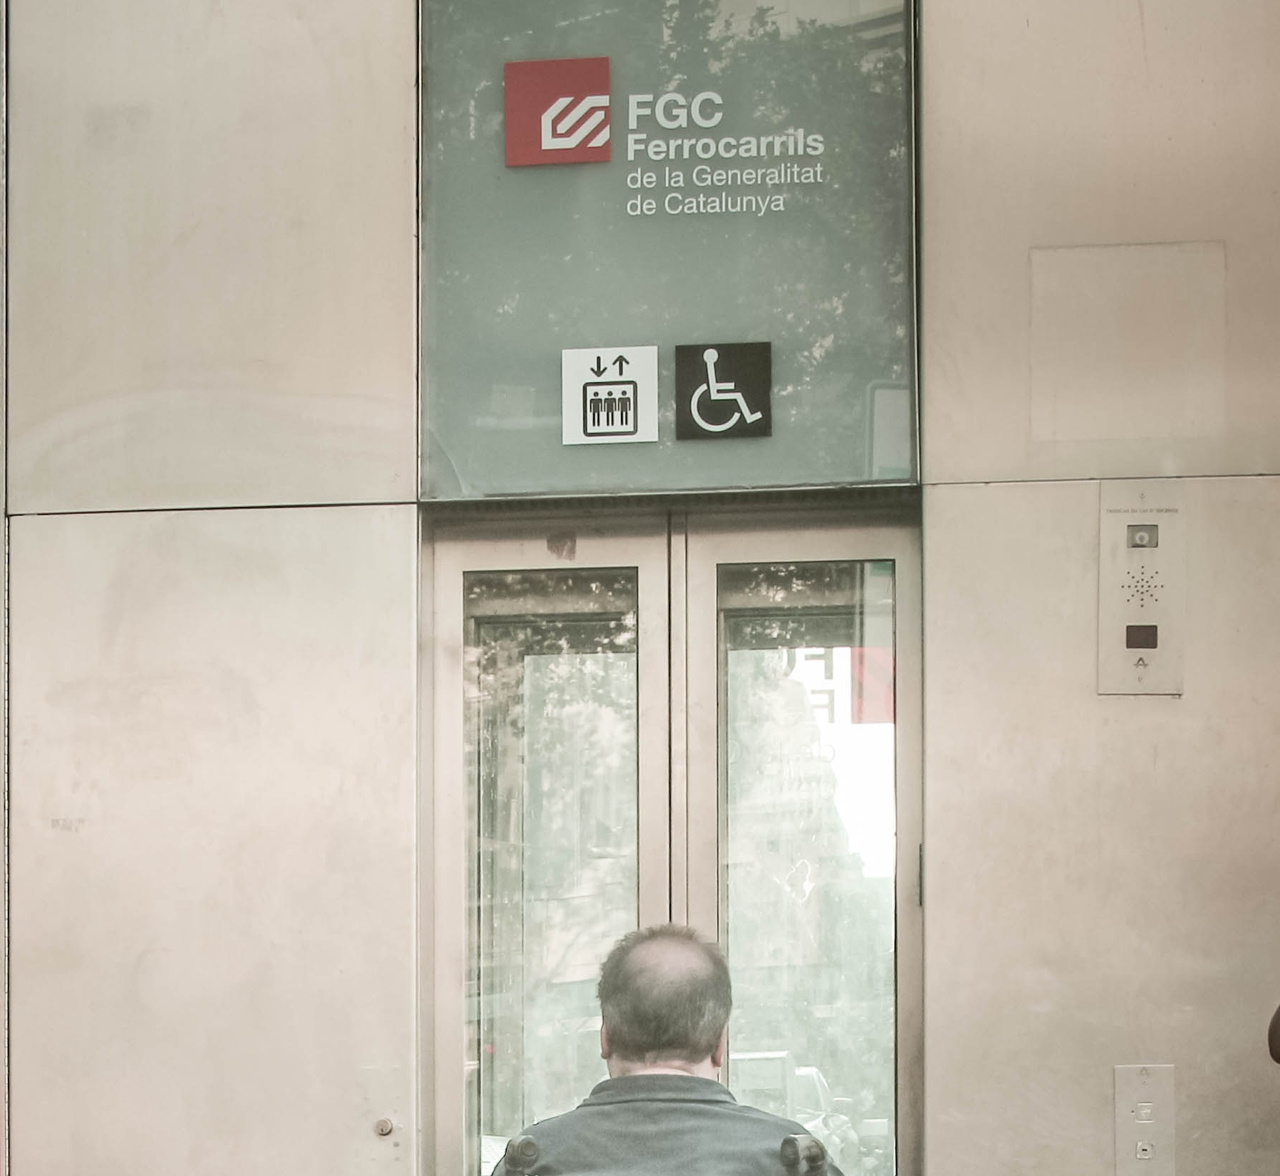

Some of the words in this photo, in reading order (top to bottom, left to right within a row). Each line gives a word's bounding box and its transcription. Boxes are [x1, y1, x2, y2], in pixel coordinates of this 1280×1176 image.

[628, 91, 723, 130] FGC
[627, 127, 825, 162] Ferrocarrils
[627, 167, 657, 189] de
[665, 166, 685, 188] la
[692, 162, 823, 187] Generalitat
[627, 194, 657, 216] de
[665, 192, 785, 217] Catalunya
